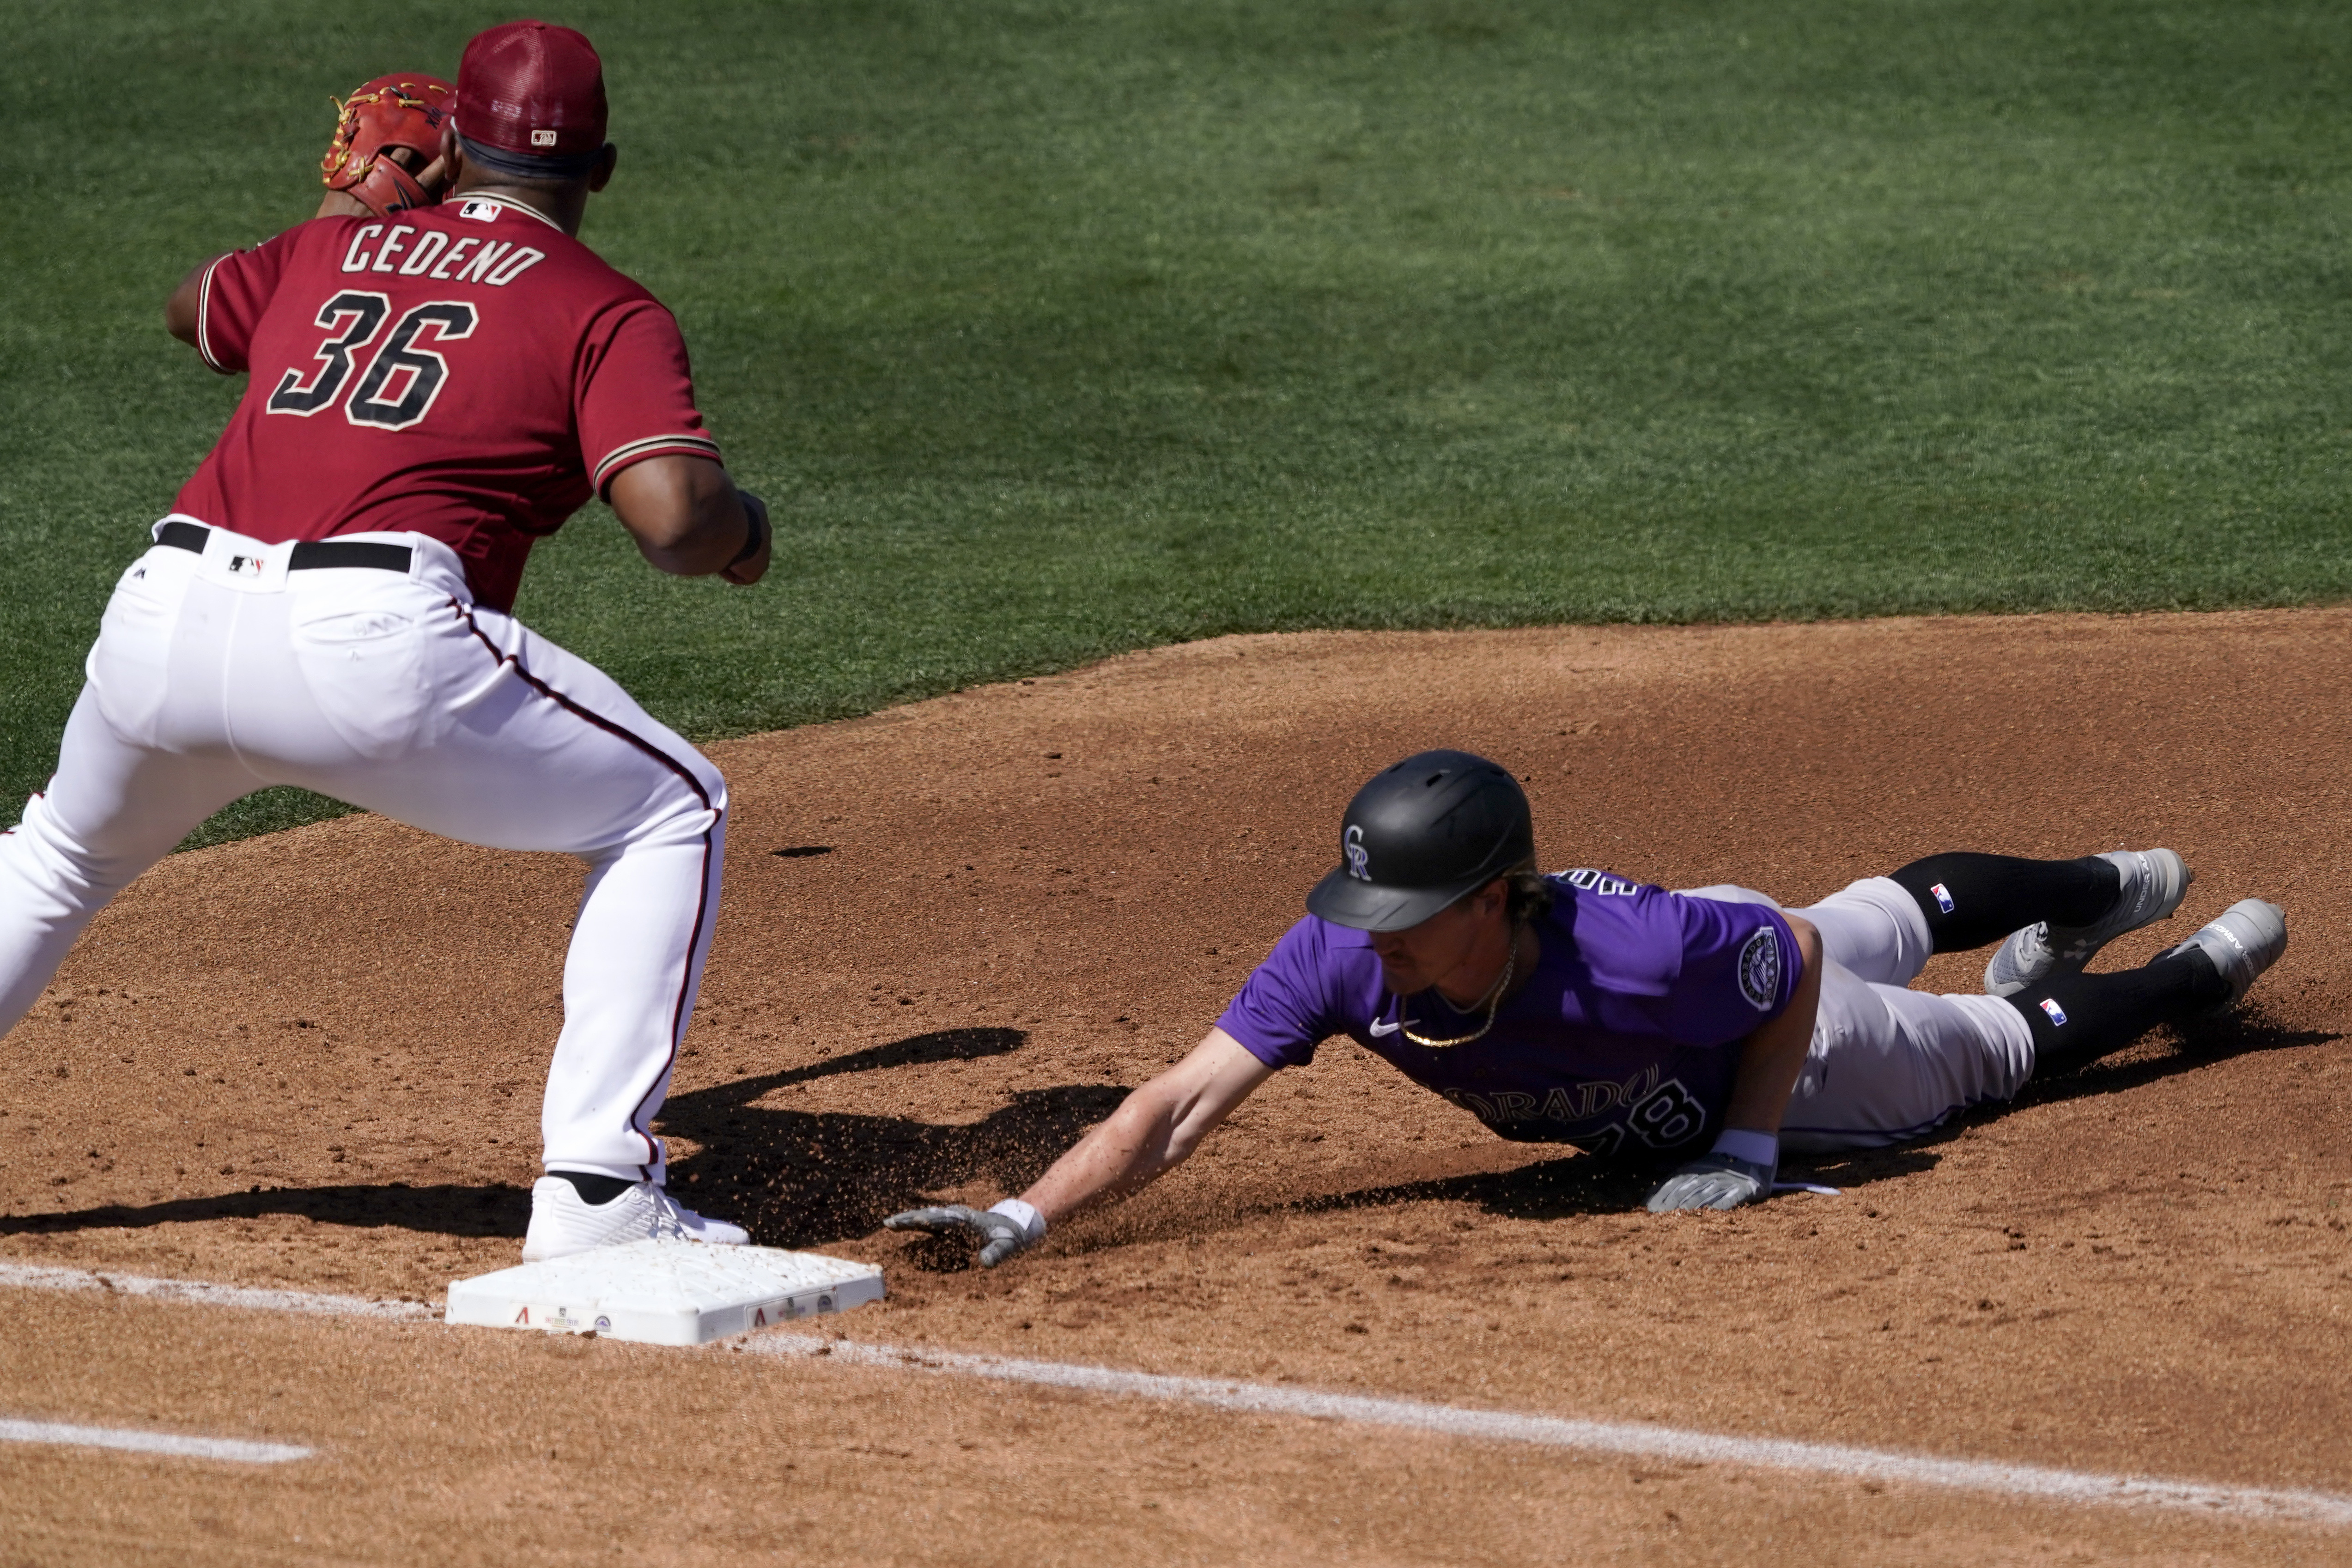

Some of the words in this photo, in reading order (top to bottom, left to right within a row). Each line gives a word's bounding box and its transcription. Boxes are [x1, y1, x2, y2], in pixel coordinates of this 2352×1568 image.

[342, 224, 546, 286] CEDENO
[266, 289, 480, 432] 36
[2134, 873, 2151, 912] UNDER
[1443, 1062, 1659, 1123] ORADO
